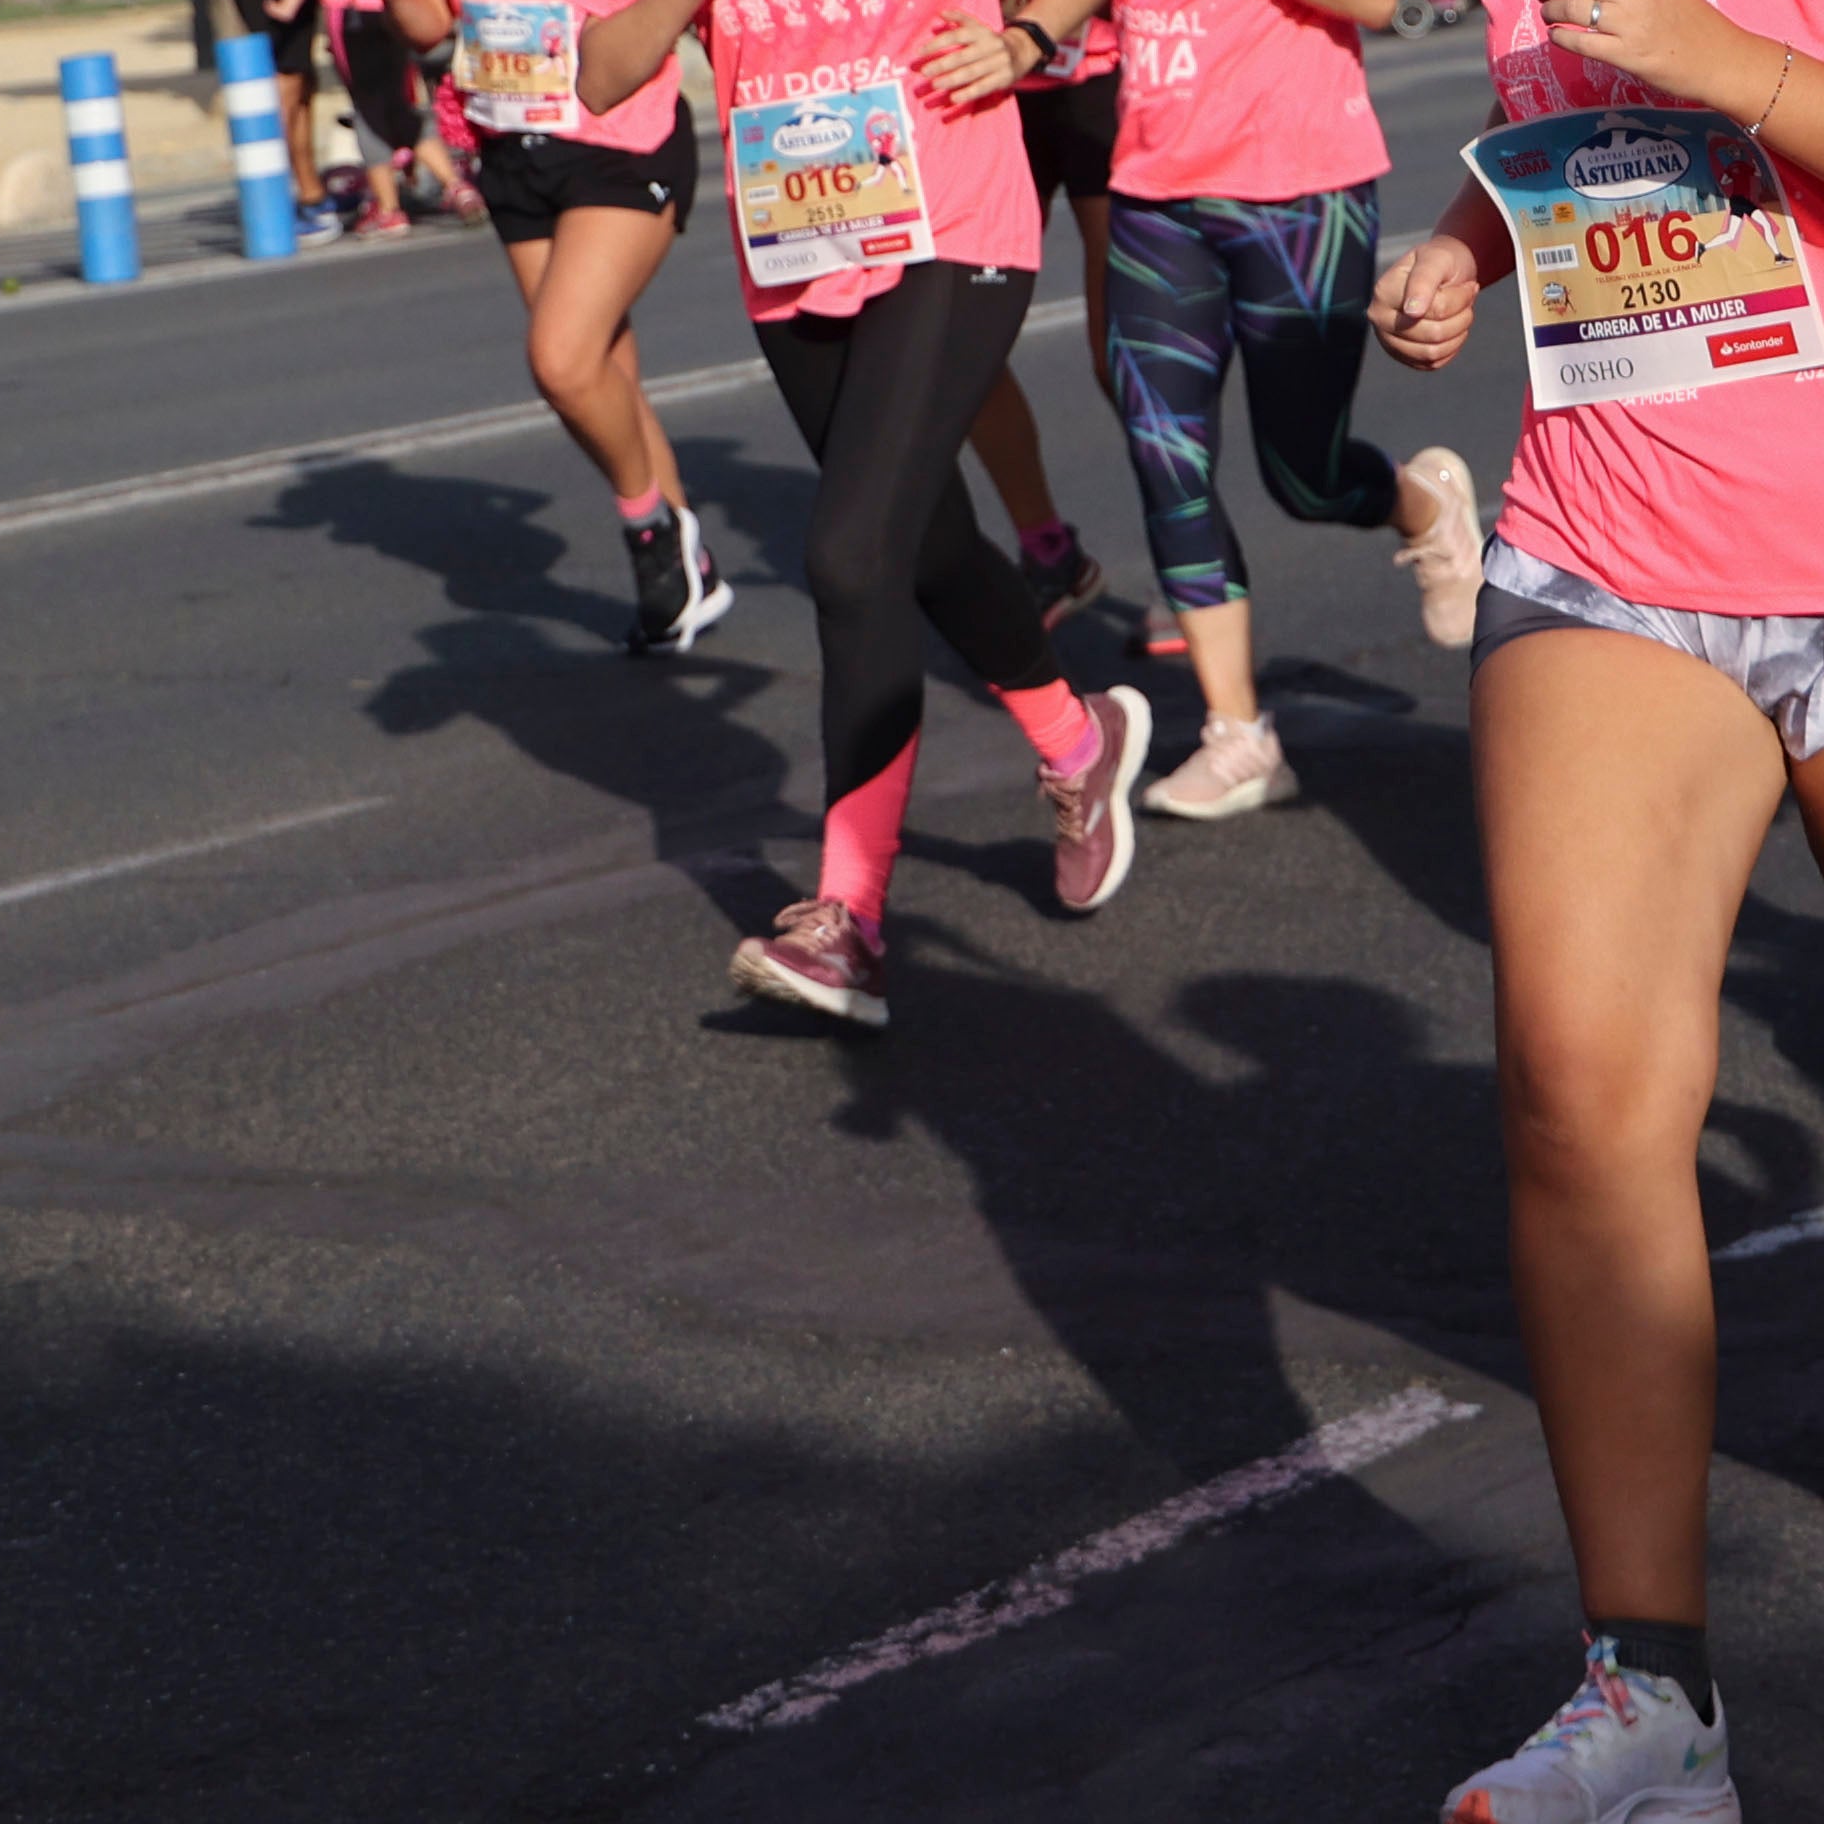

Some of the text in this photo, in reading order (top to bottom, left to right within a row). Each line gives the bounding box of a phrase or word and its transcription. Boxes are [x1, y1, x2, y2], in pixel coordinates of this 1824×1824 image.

[1130, 37, 1198, 87] MA
[784, 162, 857, 202] 016
[1573, 152, 1684, 187] ASTURIANA
[806, 203, 846, 224] 2513
[1584, 209, 1700, 274] 016
[1621, 278, 1682, 309] 2130
[1579, 298, 1748, 341] CARRERA DE LA MUJER
[1732, 334, 1785, 354] Santander
[1559, 356, 1635, 386] OYSHO
